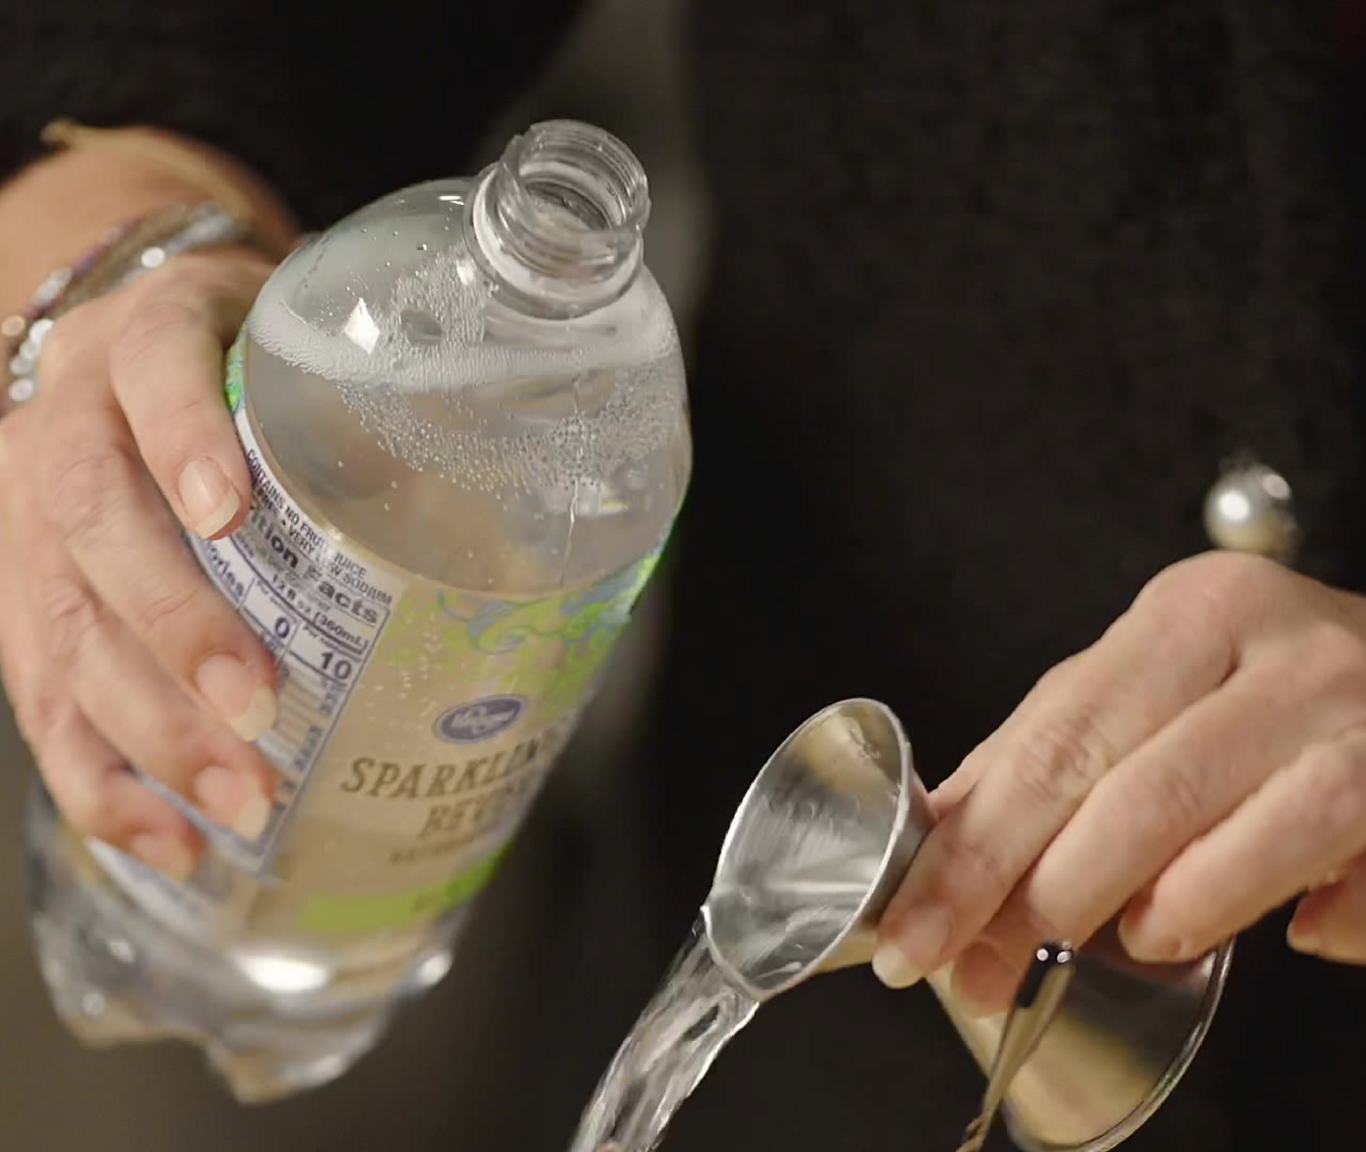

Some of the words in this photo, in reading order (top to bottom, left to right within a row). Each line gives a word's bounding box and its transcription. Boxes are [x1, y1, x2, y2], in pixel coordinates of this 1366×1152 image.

[246, 449, 286, 507] CONTAINS
[285, 506, 300, 526] NO
[289, 525, 315, 554] VERY
[343, 573, 393, 604] SODIUM
[274, 615, 291, 639] 0
[320, 651, 352, 681] 10
